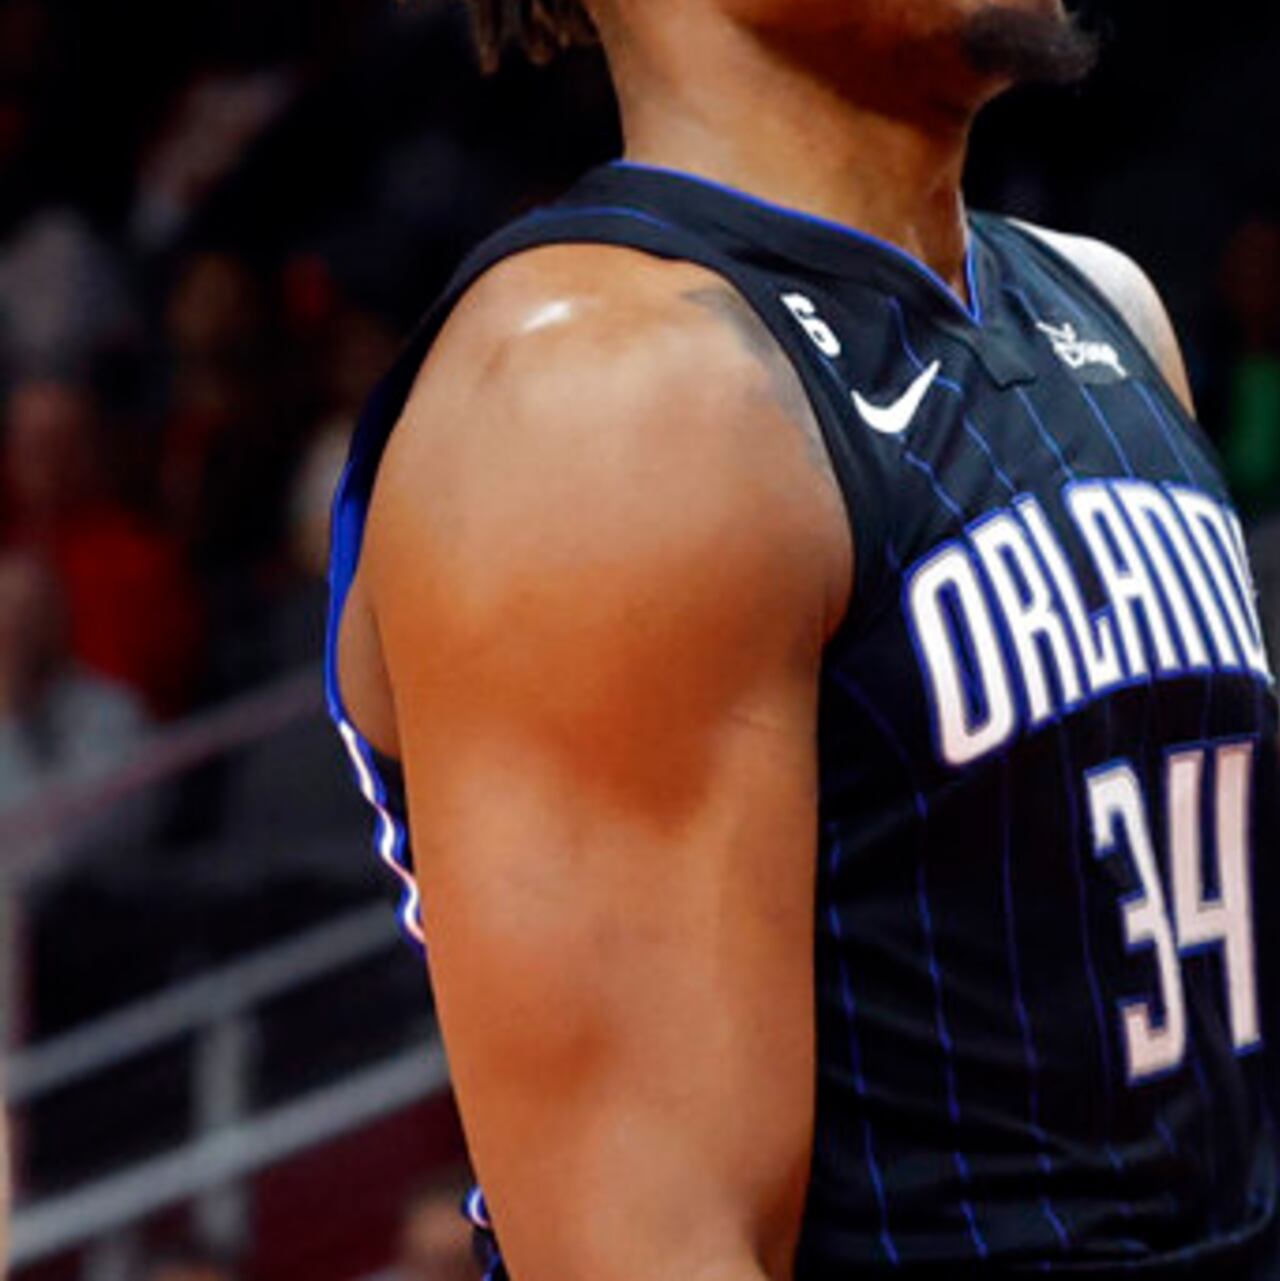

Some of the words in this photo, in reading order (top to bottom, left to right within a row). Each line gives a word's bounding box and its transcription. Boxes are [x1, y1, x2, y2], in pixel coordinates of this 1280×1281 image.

[780, 293, 842, 359] 6
[903, 477, 1276, 767] ORLAND
[1085, 733, 1262, 1088] 34
